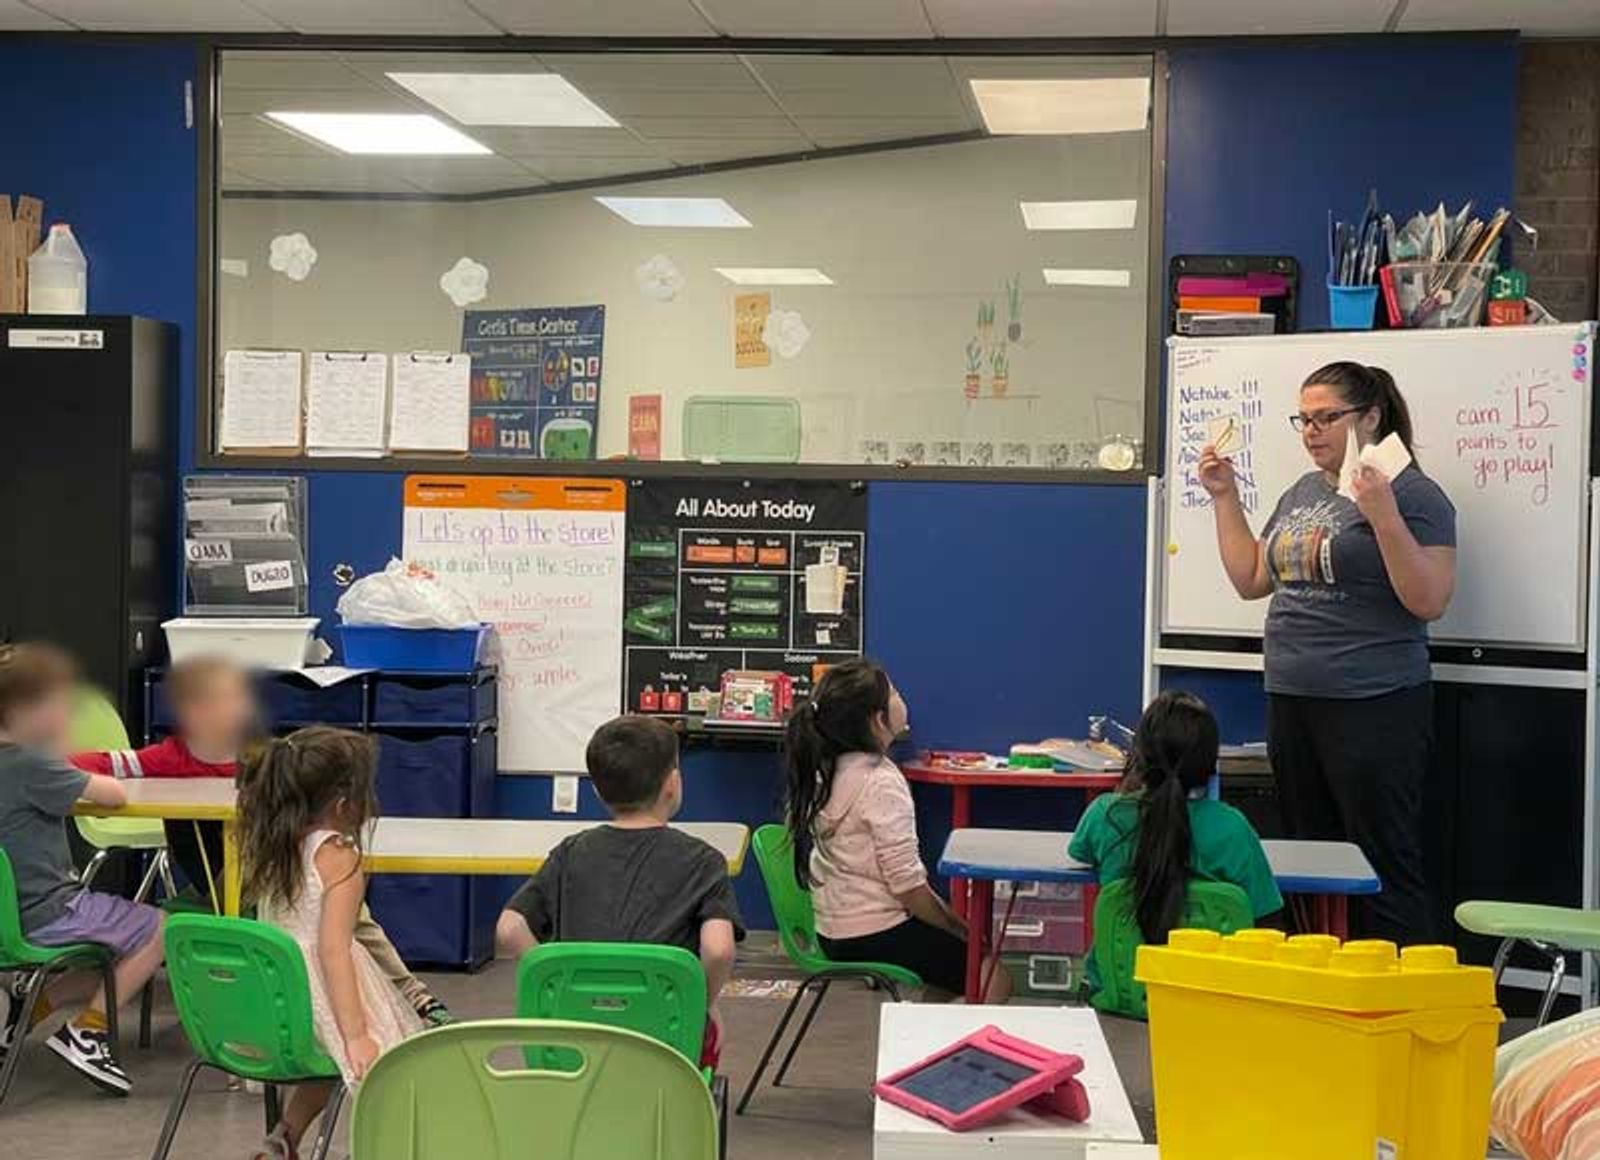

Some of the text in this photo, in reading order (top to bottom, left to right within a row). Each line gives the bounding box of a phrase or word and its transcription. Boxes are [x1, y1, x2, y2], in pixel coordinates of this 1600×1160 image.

[1514, 382, 1550, 427] 15
[1518, 432, 1538, 451] to
[1474, 457, 1498, 489] go
[675, 498, 815, 522] All About Today
[417, 511, 464, 541] Let's
[471, 525, 493, 557] go
[498, 511, 519, 543] to
[522, 514, 552, 543] the
